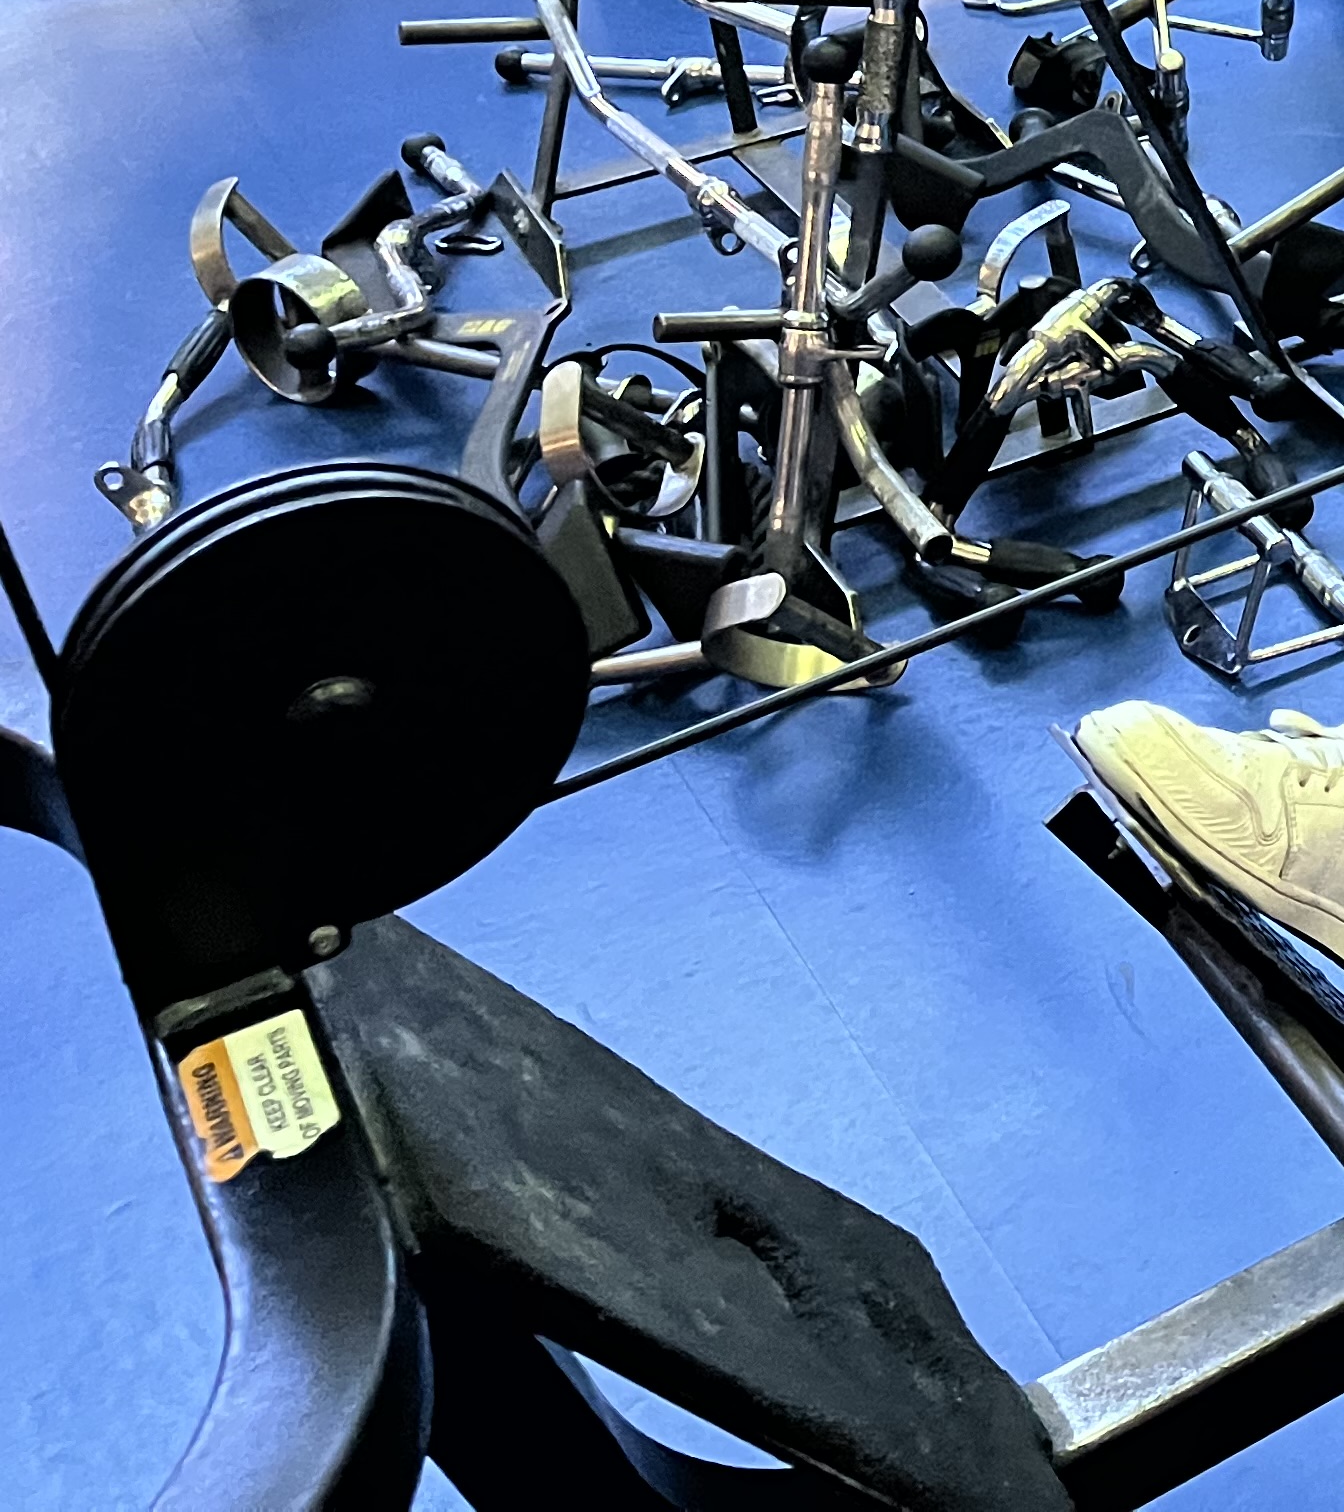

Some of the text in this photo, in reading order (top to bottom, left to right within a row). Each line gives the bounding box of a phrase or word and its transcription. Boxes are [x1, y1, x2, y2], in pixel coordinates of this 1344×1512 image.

[192, 1062, 237, 1148] WARNING
[247, 1053, 290, 1131] KEEP CLEAR
[267, 1027, 322, 1140] OF MOVING PARTS
